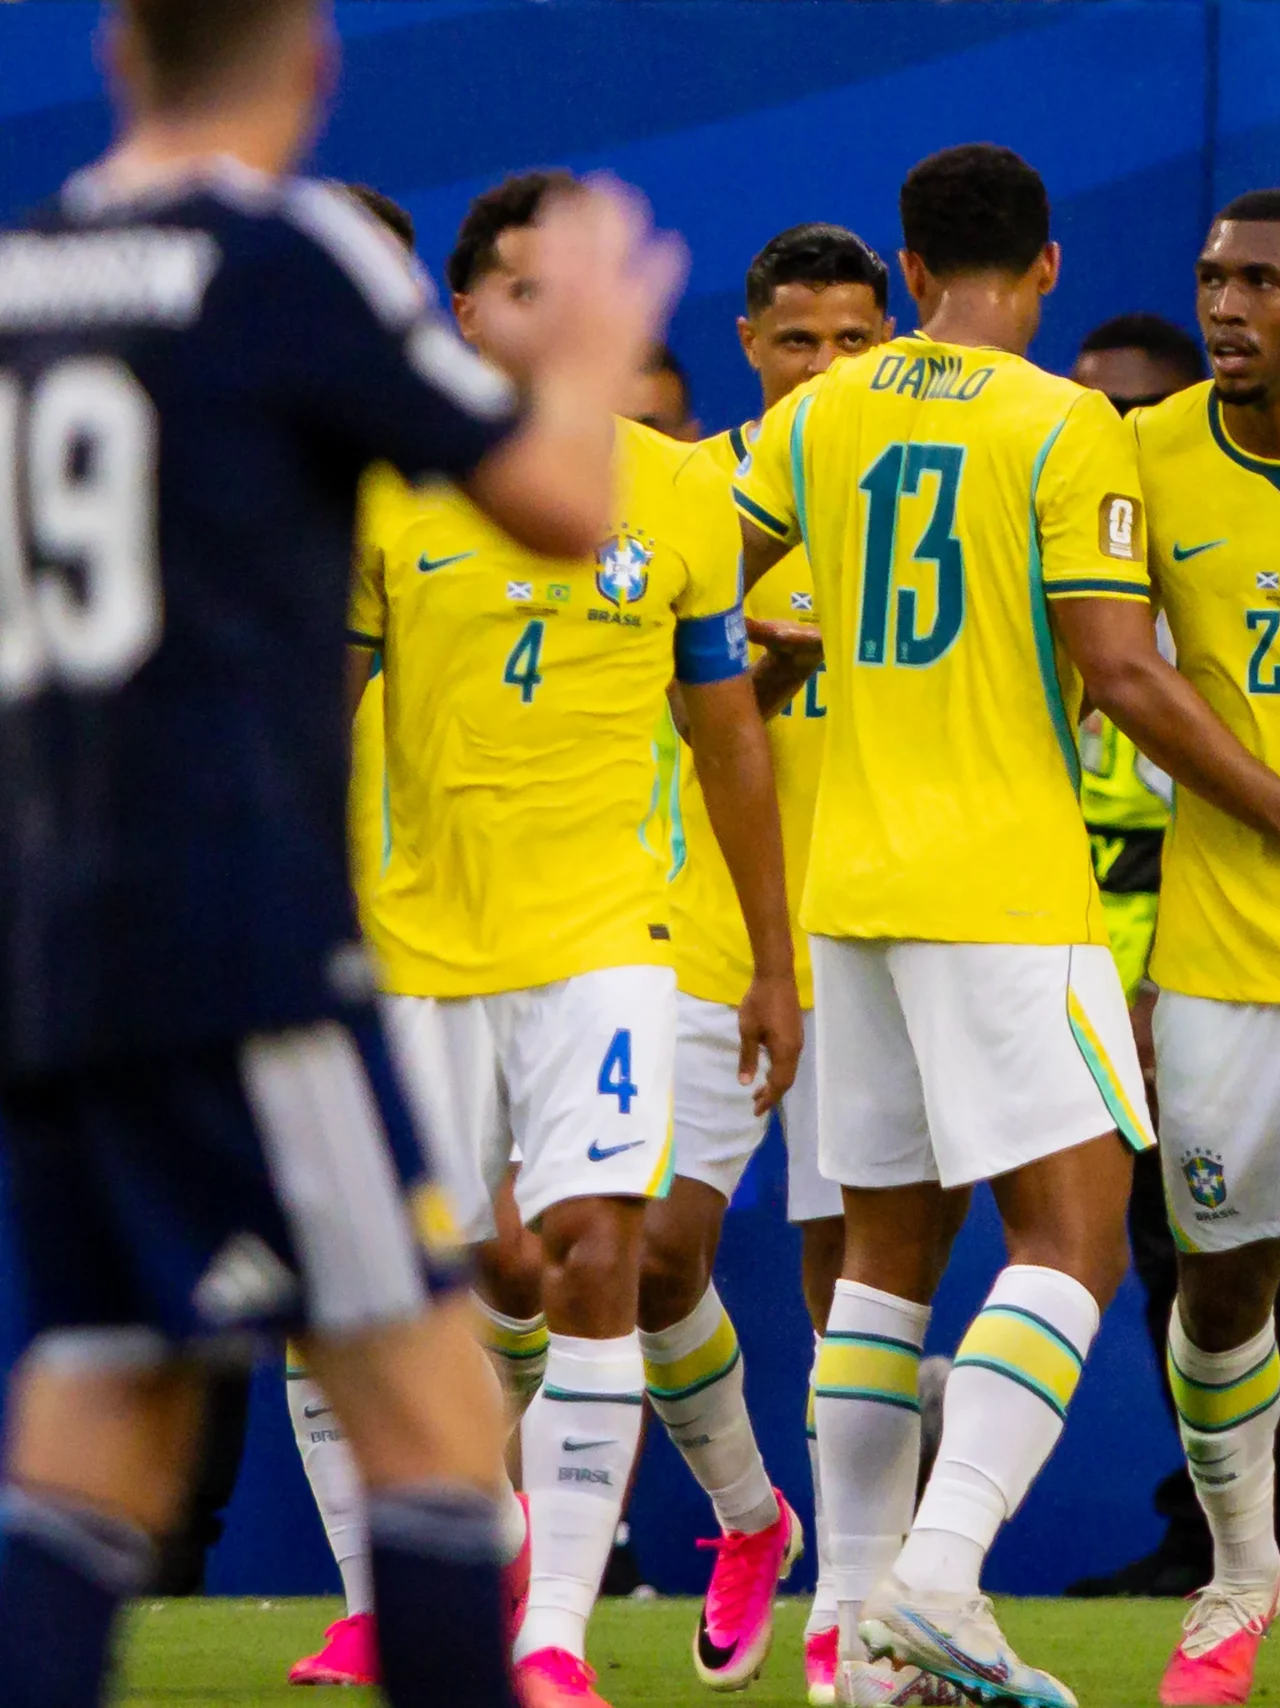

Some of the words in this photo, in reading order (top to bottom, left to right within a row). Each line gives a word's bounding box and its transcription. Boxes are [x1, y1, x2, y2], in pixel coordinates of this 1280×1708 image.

[870, 355, 996, 401] DANILO
[856, 442, 965, 669] 13
[503, 618, 546, 703] 4
[587, 608, 642, 628] BRASIL
[597, 1027, 638, 1114] 4
